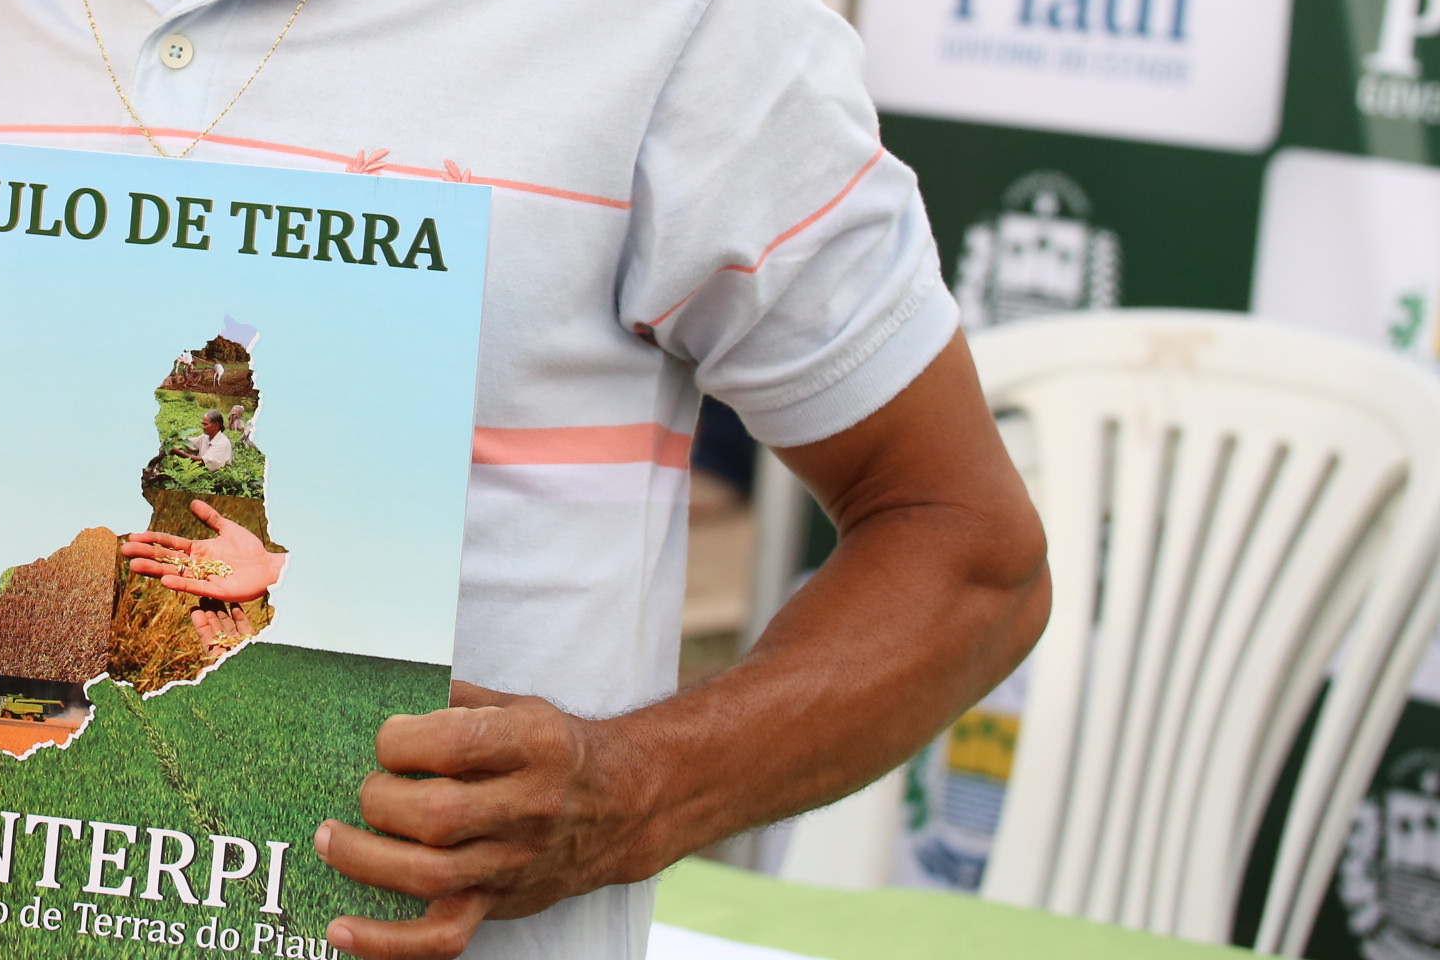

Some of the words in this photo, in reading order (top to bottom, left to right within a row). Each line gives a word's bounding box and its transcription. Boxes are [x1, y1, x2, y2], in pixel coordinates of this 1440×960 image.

[125, 192, 213, 250] DE
[230, 201, 449, 272] TERRA
[19, 896, 62, 931] de
[73, 902, 187, 945] Terras
[196, 917, 240, 951] do
